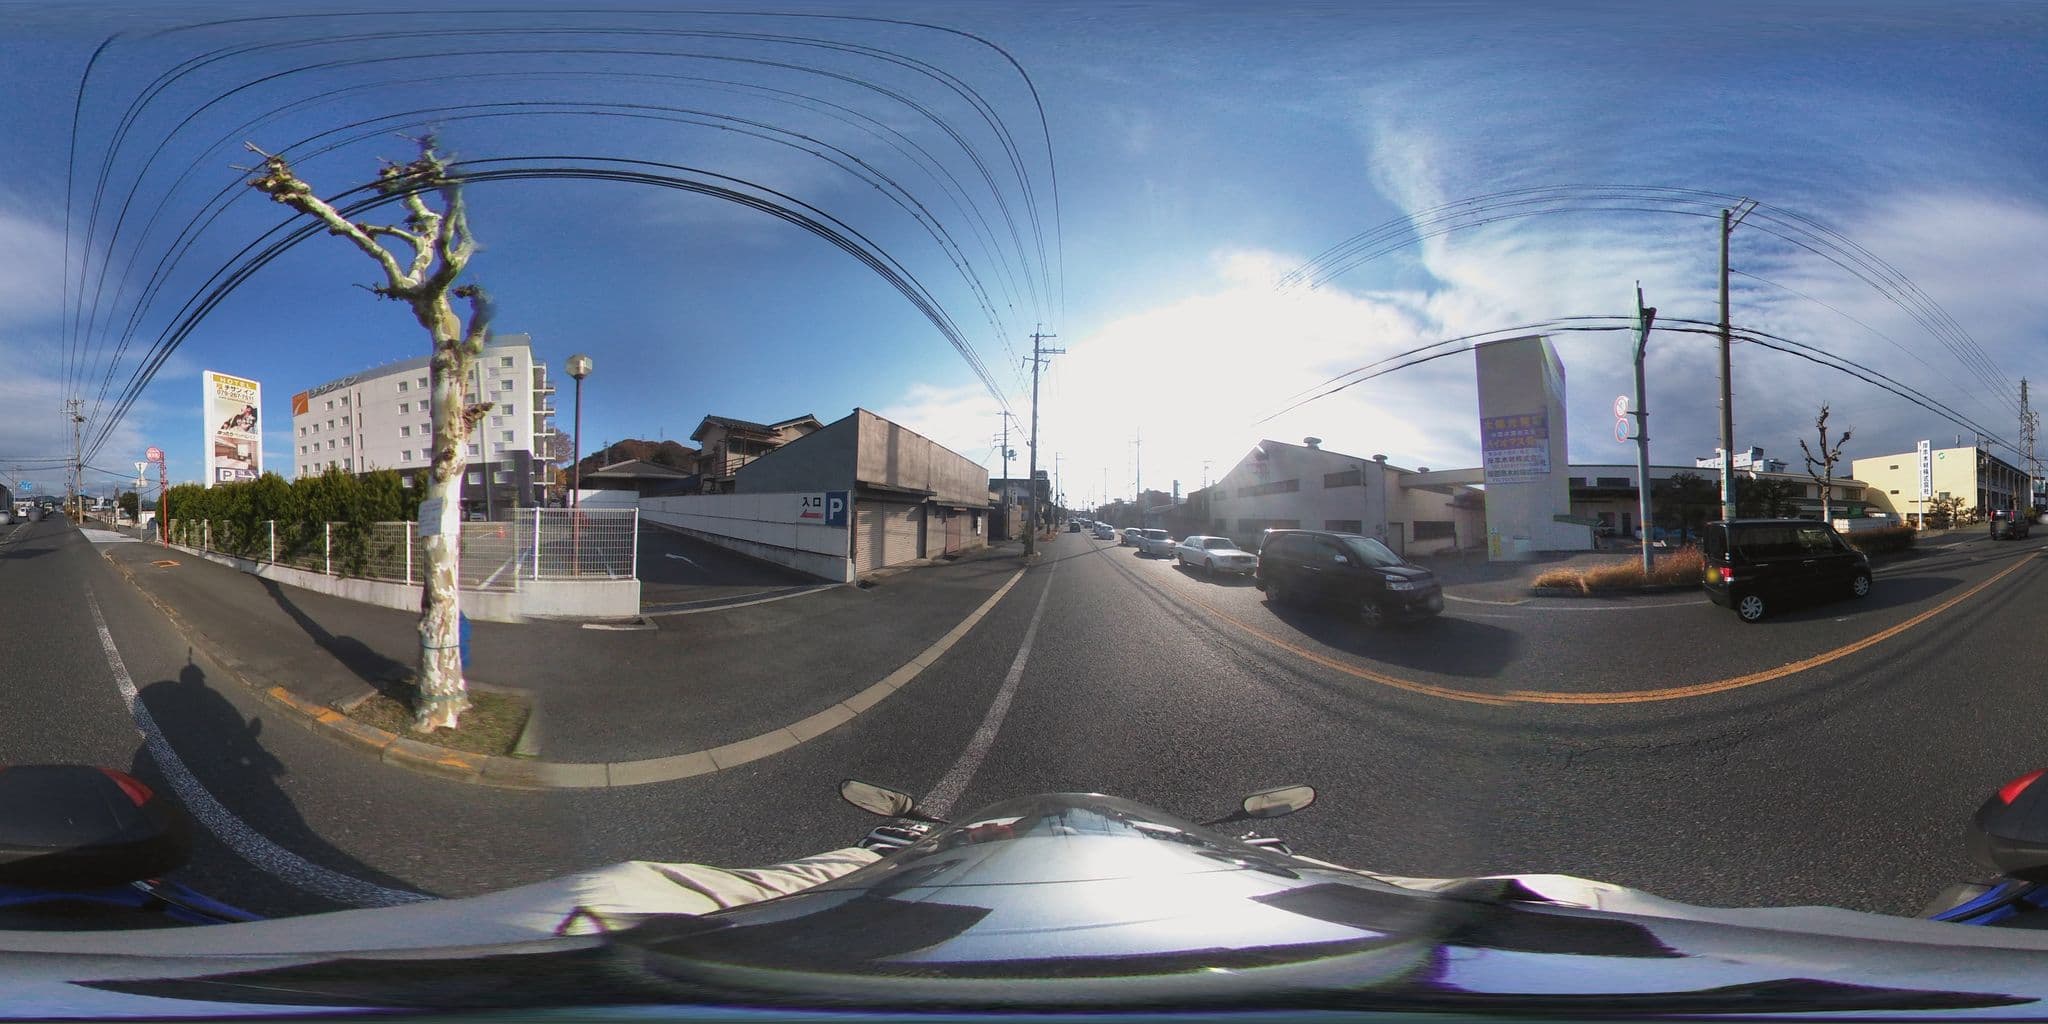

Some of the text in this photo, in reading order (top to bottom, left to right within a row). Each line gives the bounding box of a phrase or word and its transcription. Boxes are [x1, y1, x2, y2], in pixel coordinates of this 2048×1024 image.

[220, 376, 251, 388] HOTEL
[223, 470, 233, 480] P
[802, 497, 821, 508] 入口
[829, 498, 843, 520] P
